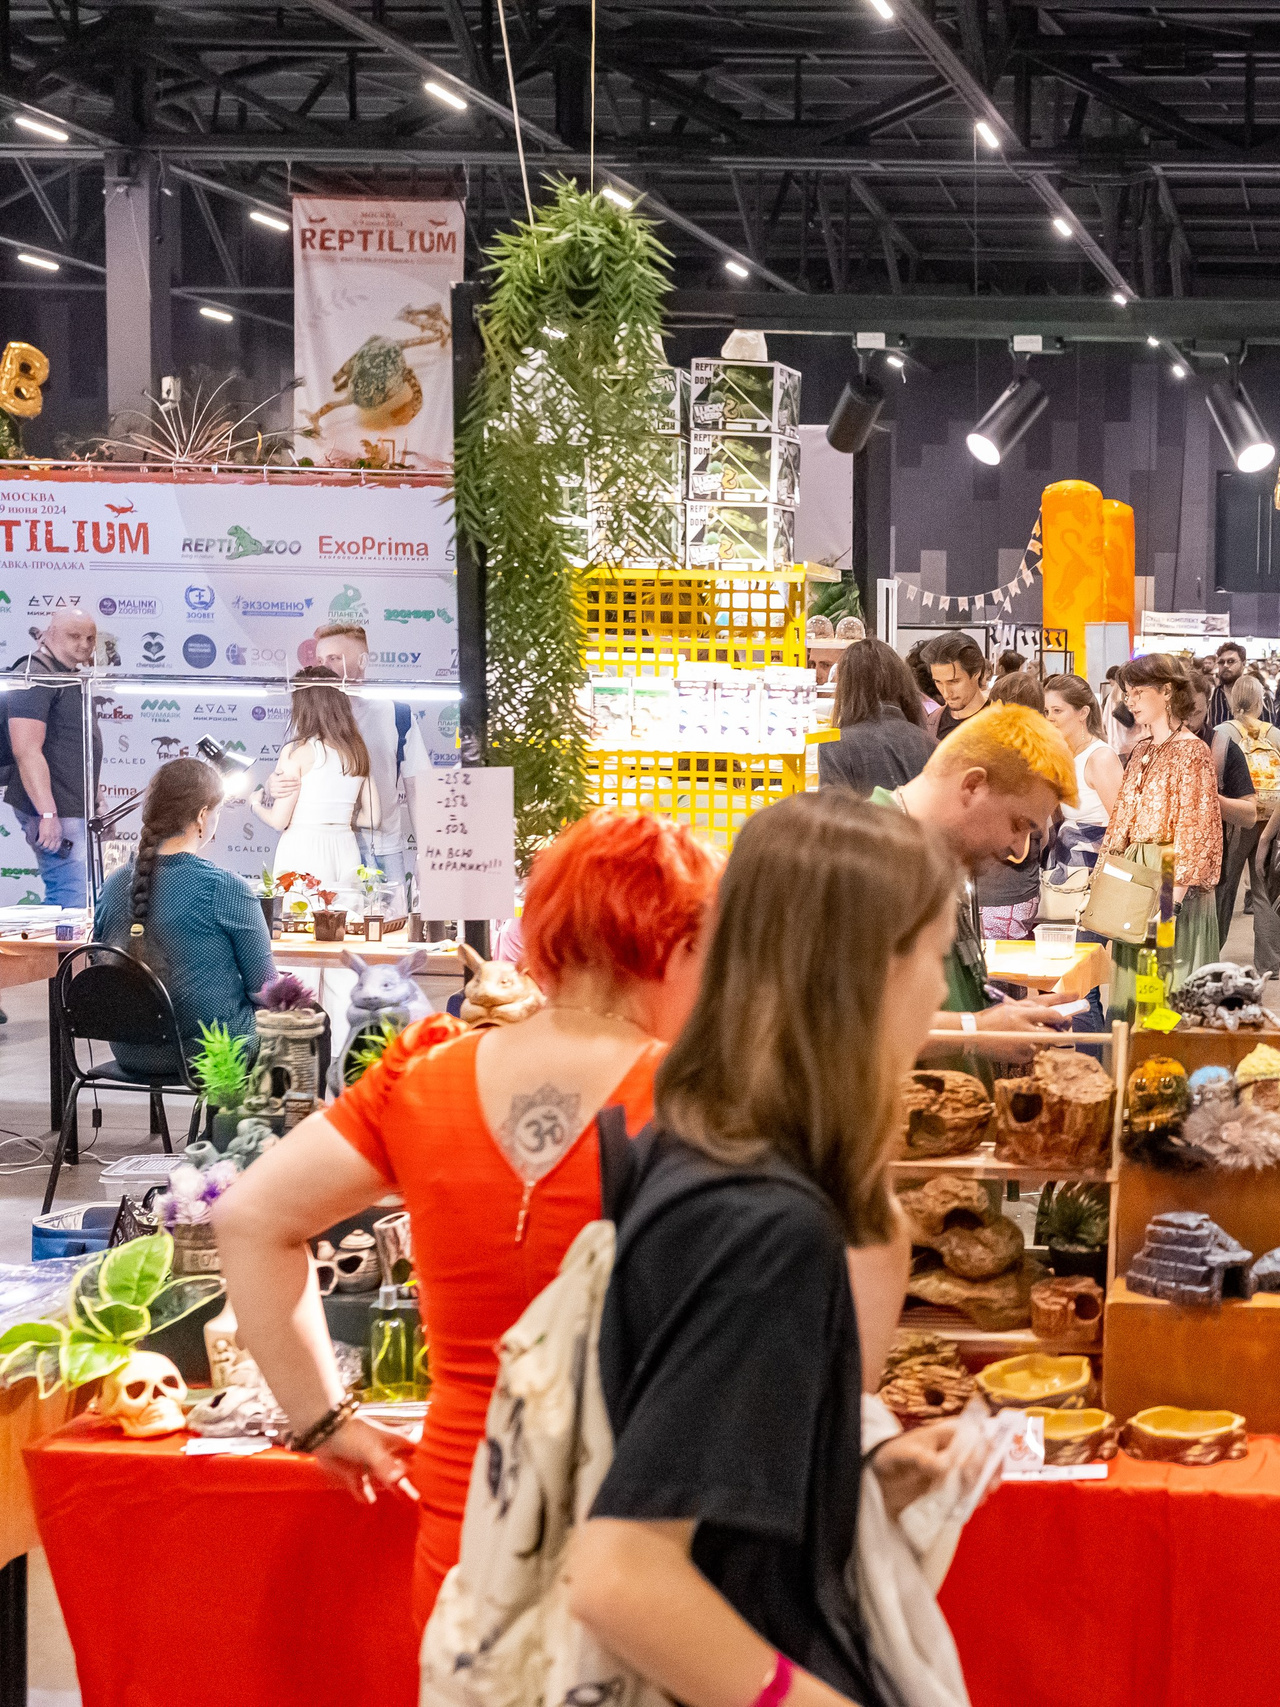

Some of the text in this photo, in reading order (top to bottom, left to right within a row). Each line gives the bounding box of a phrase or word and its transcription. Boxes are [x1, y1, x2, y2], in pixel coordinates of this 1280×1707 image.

[300, 228, 457, 254] REPTILIUM
[1, 492, 55, 502] МОСКВА
[8, 506, 38, 514] июня
[40, 505, 66, 515] 2024
[319, 535, 429, 556] ExoPrima
[118, 600, 157, 608] MALINKI
[242, 601, 304, 611] ЭКЗОМЕНЮ
[186, 611, 215, 619] ЗООВЕТ
[227, 845, 271, 853] SCALED
[425, 846, 442, 858] НА
[447, 847, 473, 859] ВСЮ
